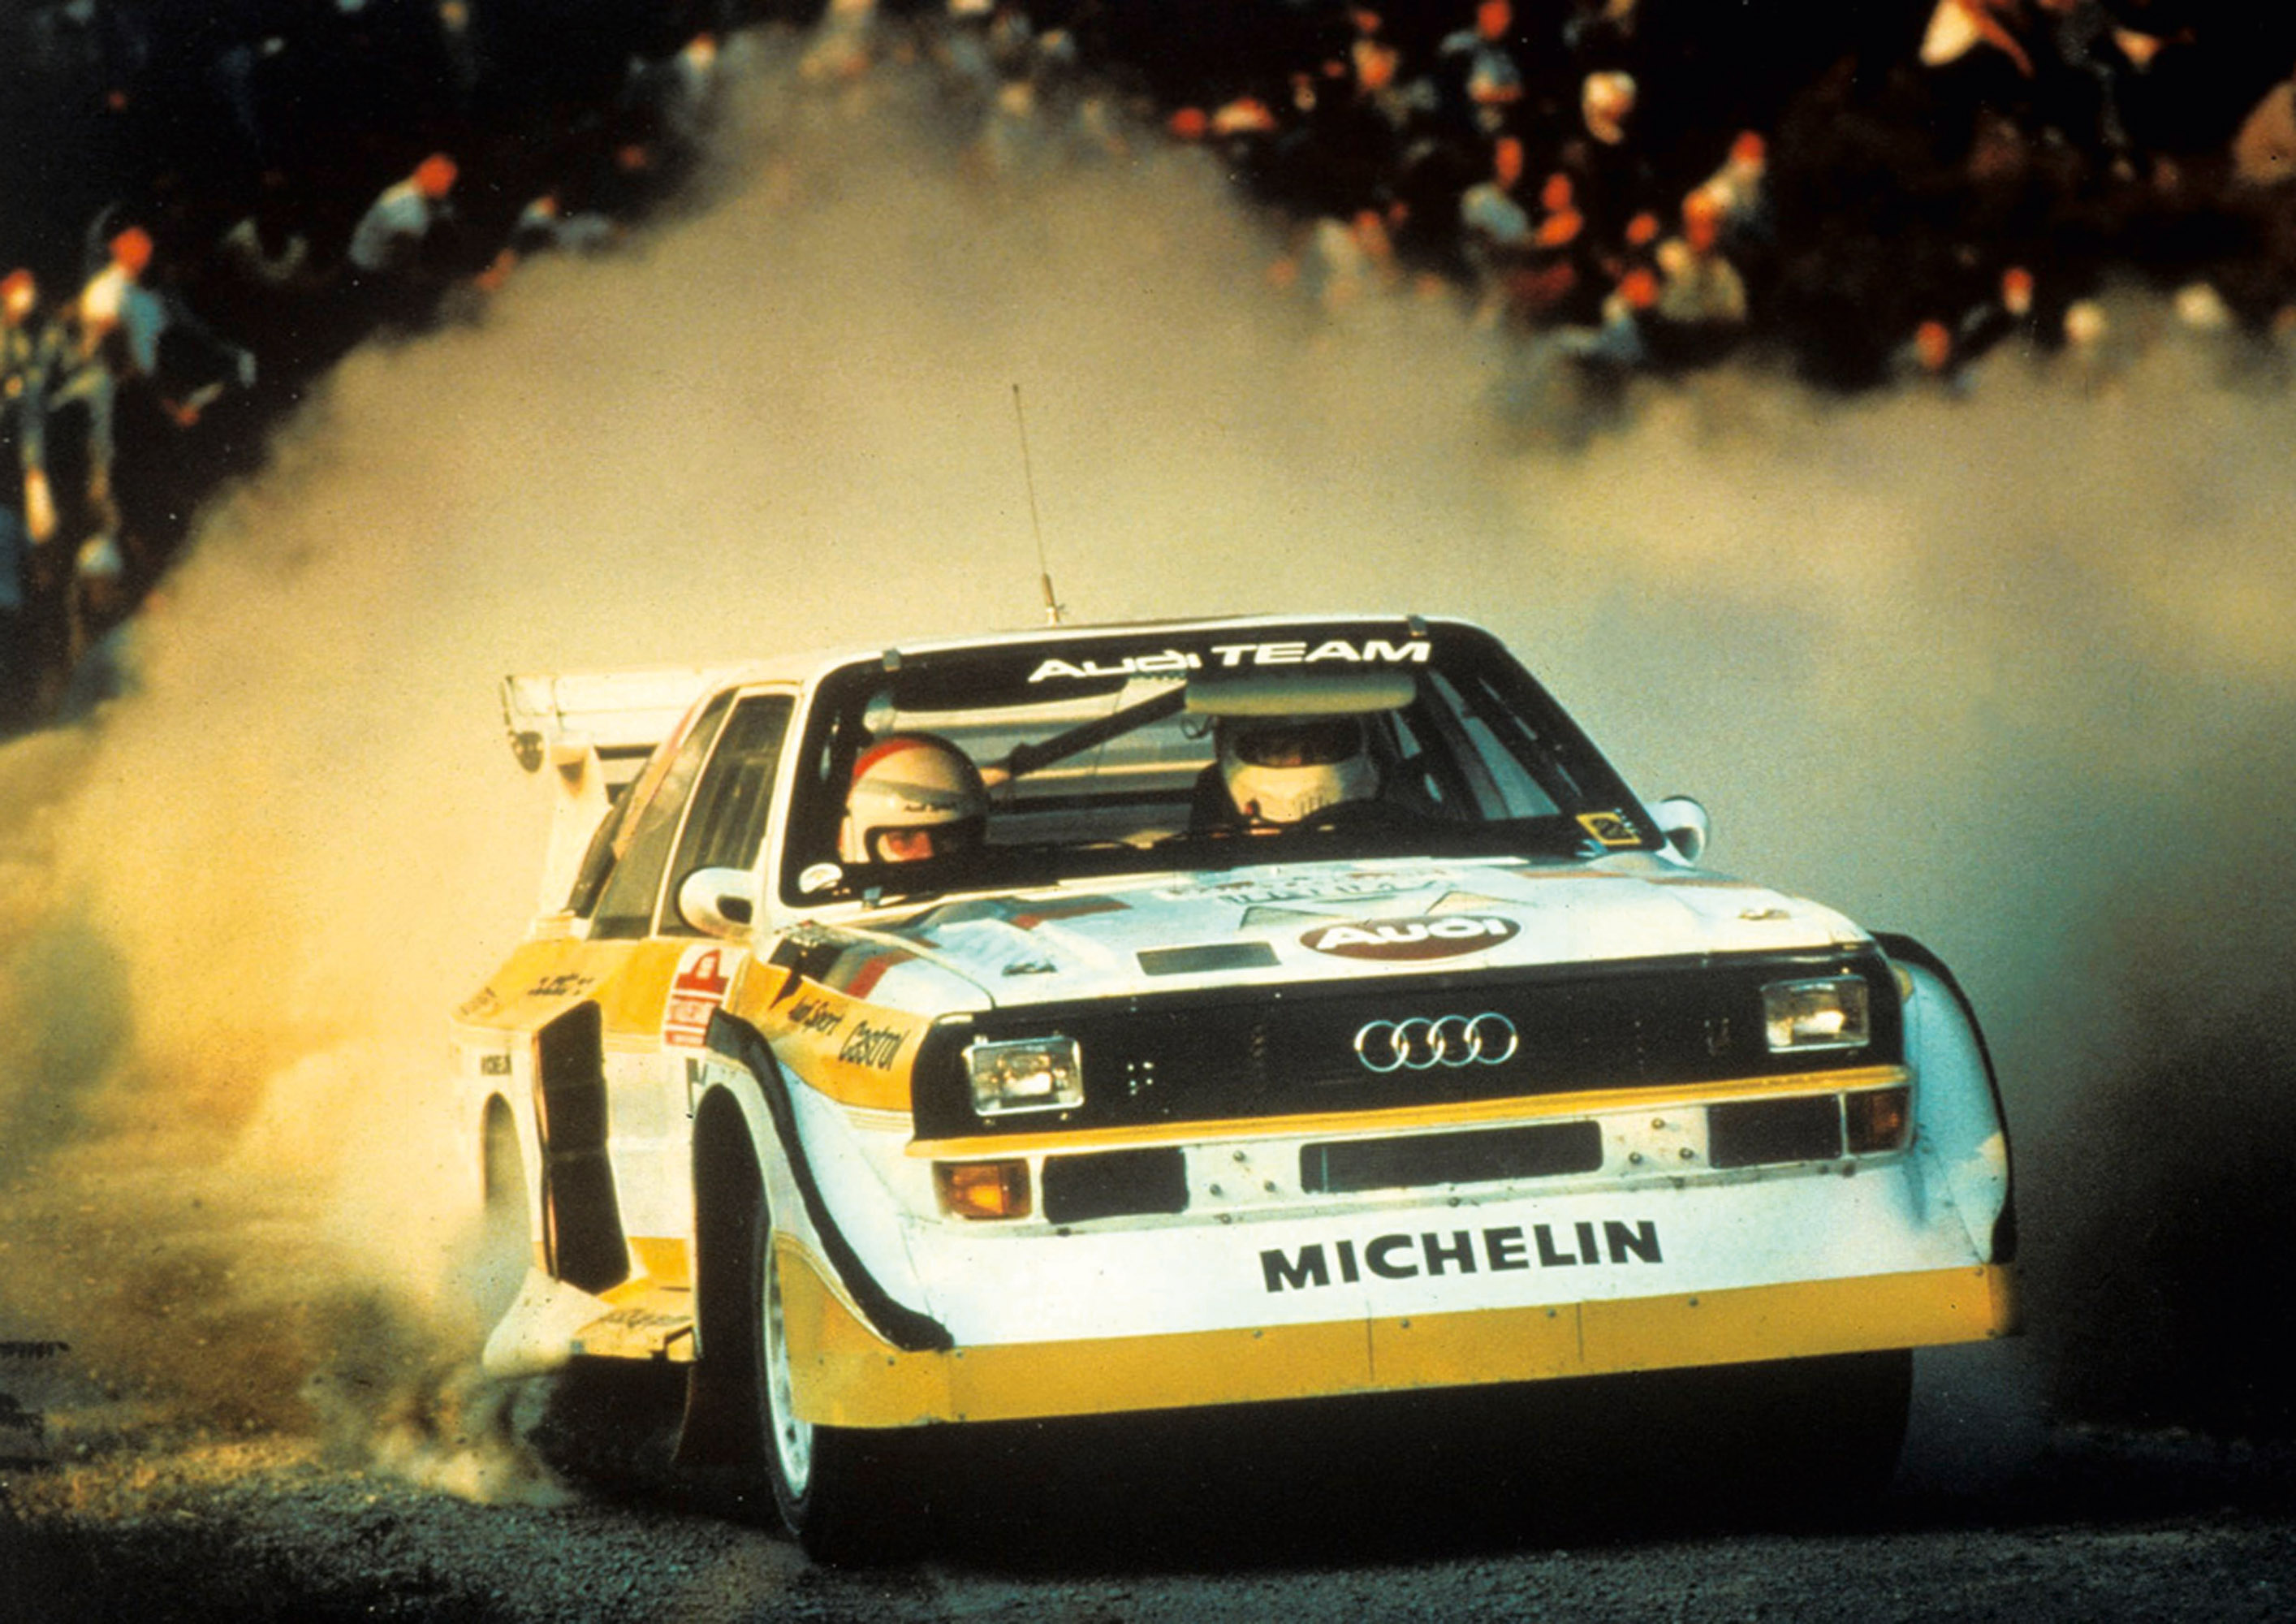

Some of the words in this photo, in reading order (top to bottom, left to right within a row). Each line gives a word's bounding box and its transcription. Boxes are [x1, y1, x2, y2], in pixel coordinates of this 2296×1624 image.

[1211, 639, 1432, 668] TEAM
[838, 1018, 912, 1073] Castrol
[1258, 1220, 1664, 1294] MICHELIN
